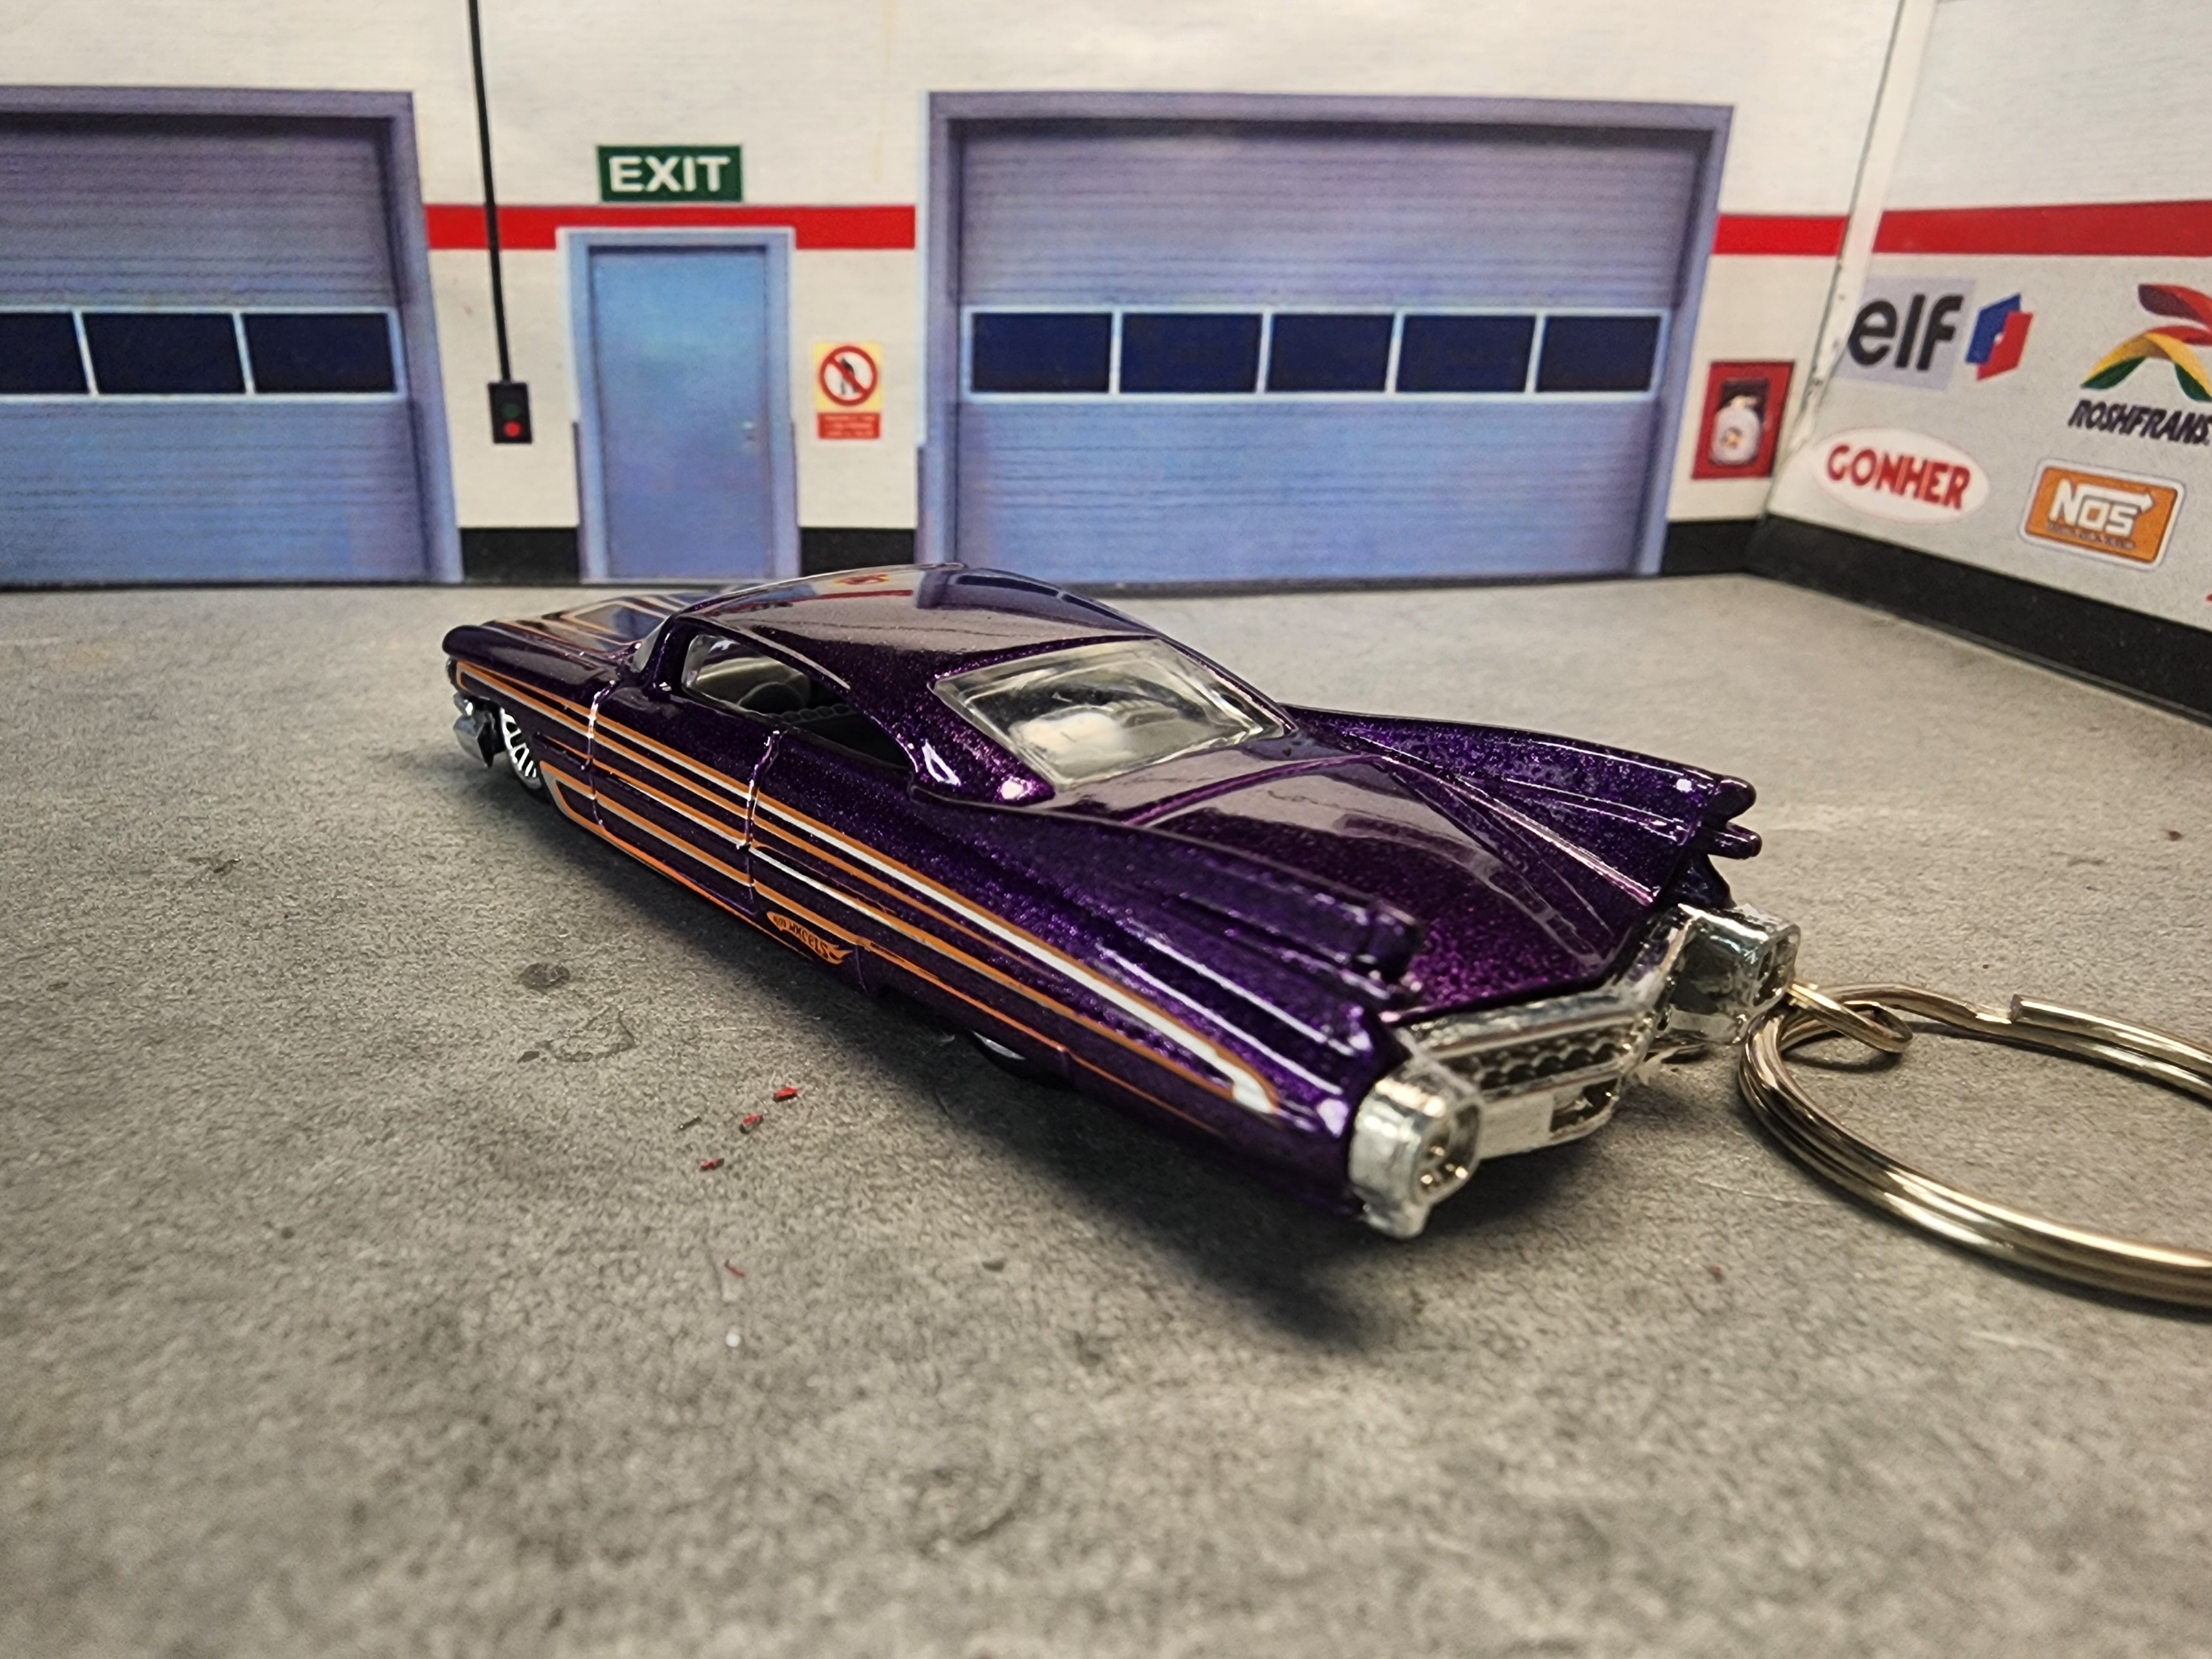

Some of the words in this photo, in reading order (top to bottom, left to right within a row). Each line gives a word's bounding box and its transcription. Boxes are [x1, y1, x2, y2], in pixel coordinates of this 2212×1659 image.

[609, 155, 731, 192] EXIT
[1848, 294, 1964, 372] elf
[2048, 478, 2153, 537] NOS
